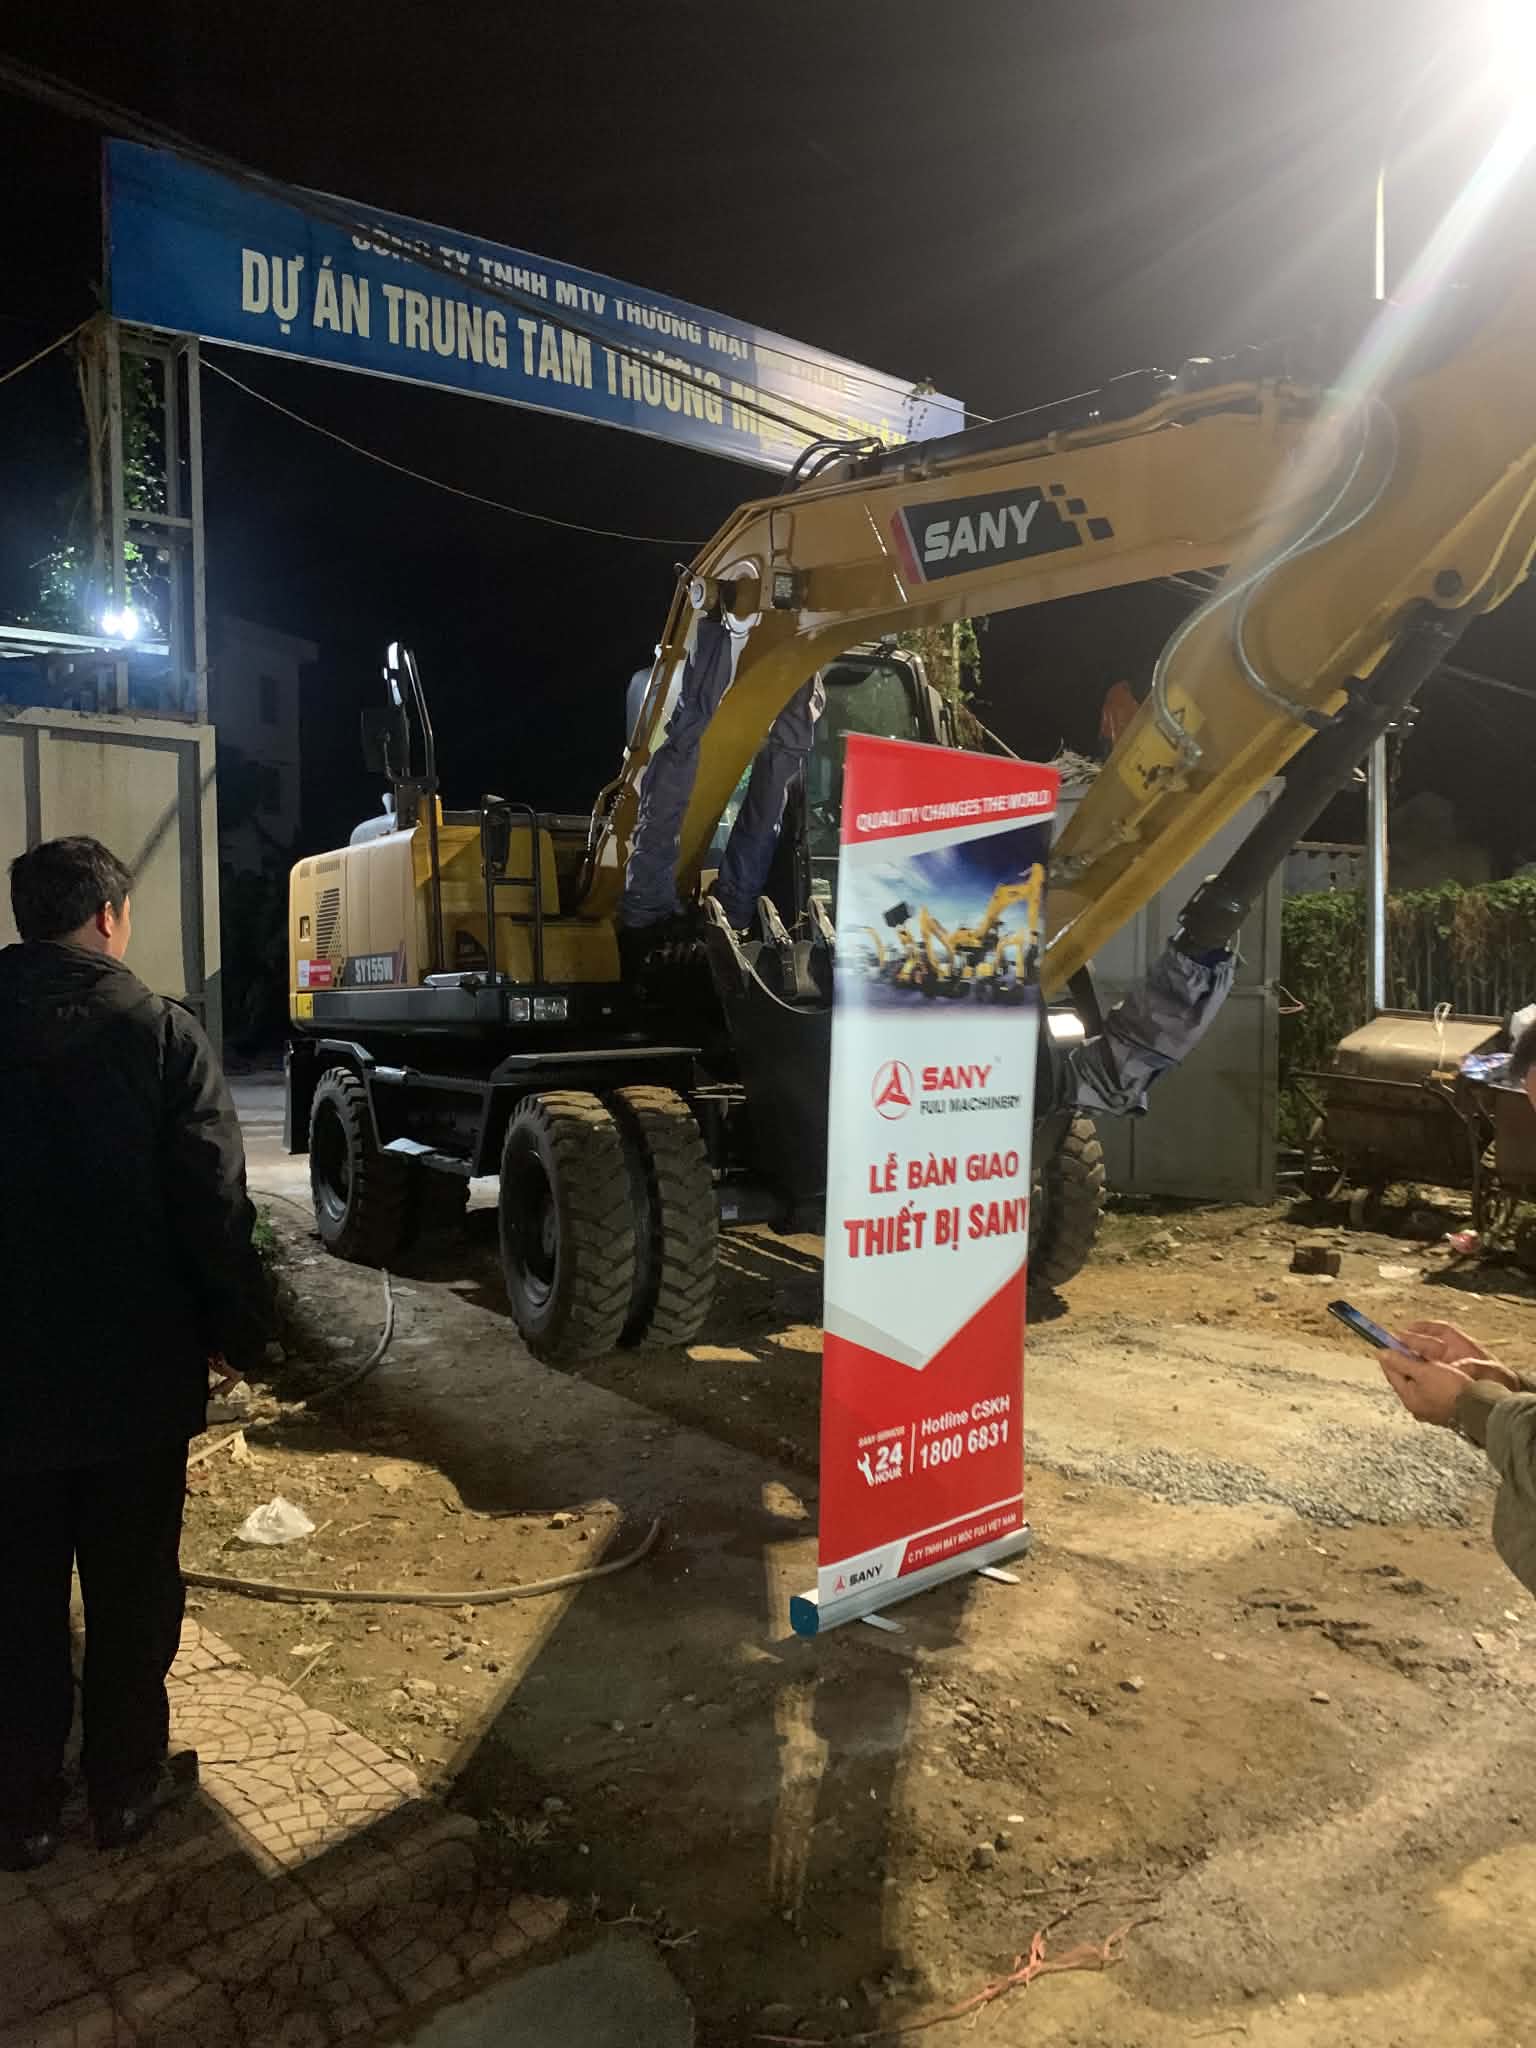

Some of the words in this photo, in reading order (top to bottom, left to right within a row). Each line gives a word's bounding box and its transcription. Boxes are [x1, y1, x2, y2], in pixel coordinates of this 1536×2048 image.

[242, 248, 304, 334] DỰ
[313, 256, 370, 338] ÁN
[383, 283, 507, 370] TRUNG
[479, 257, 547, 298] TNHH
[555, 279, 605, 314] MTV
[708, 326, 748, 362] MẠI
[924, 500, 1040, 562] SANY
[857, 808, 919, 832] QUALITY
[921, 800, 980, 823] CHANGES
[982, 797, 1006, 813] THE
[1007, 789, 1051, 809] WORLD
[922, 1065, 992, 1091] SANY
[949, 1095, 1021, 1113] MACHINERY
[869, 1152, 898, 1194] LỄ
[907, 1152, 957, 1190] BÀN
[966, 1150, 1018, 1182] GIAO
[844, 1200, 927, 1258] THIẾT
[935, 1207, 960, 1251] BỊ
[921, 1409, 968, 1437] Hotline
[971, 1394, 1010, 1421] CSKH
[875, 1441, 904, 1471] 24
[920, 1433, 962, 1469] 1800
[968, 1419, 1009, 1454] 6831
[849, 1563, 883, 1587] SANY
